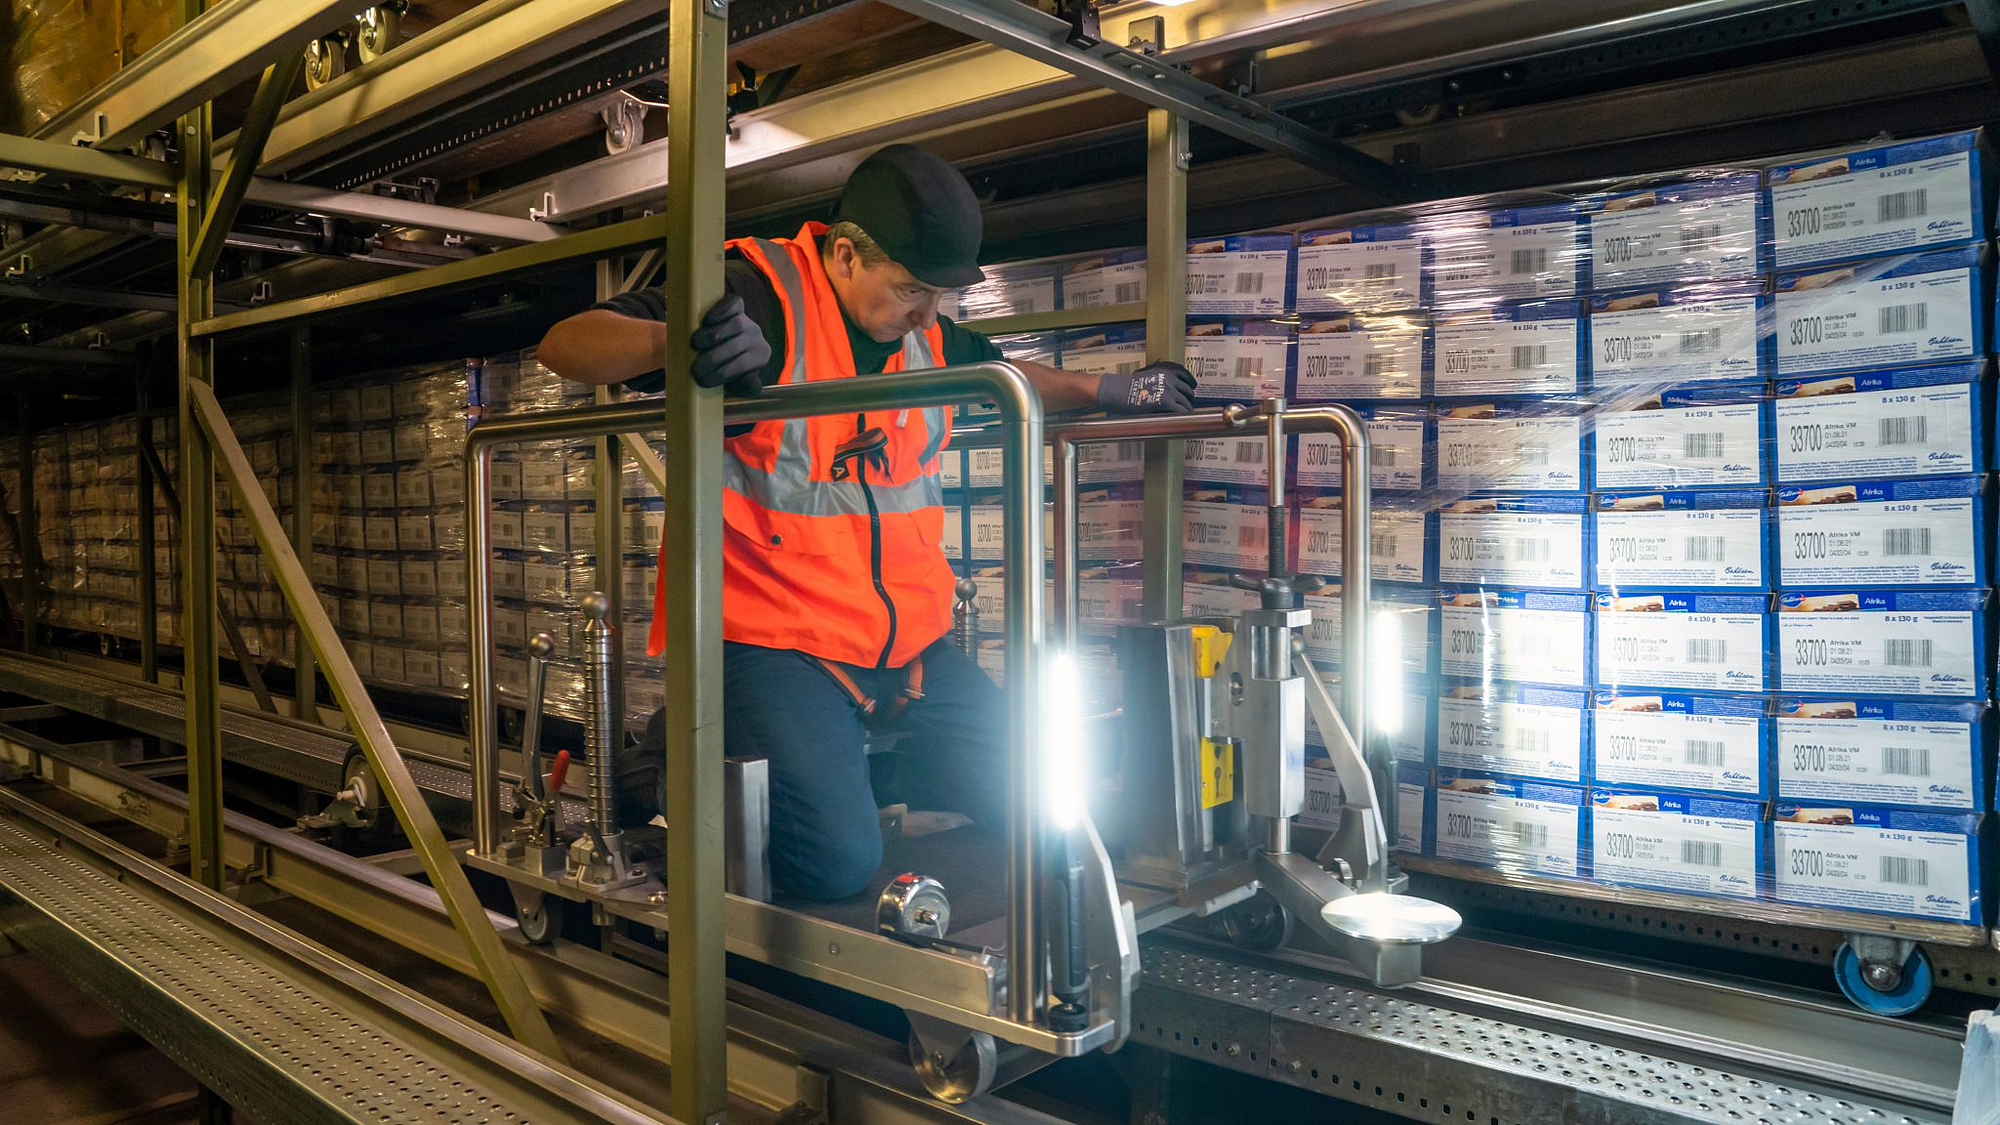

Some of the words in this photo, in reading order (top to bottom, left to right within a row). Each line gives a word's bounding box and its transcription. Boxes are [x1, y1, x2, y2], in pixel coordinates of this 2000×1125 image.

[1855, 157, 1875, 166] Afrika
[1788, 207, 1820, 238] 33700
[1790, 316, 1822, 345] 33700
[1604, 337, 1631, 363] 33700
[1609, 437, 1635, 462] 33700
[1791, 424, 1822, 452] 33700
[1450, 537, 1474, 560] 33700
[1610, 538, 1636, 562] 33700
[1795, 532, 1825, 559] 33700
[1312, 618, 1333, 640] 33700
[1452, 630, 1475, 654] 33700
[1796, 639, 1826, 665] 33700
[1450, 721, 1474, 746] 33700
[1610, 736, 1636, 761] 33700
[1794, 745, 1825, 772] 33700
[1309, 789, 1331, 813] 33700
[1607, 833, 1633, 858] 33700
[1792, 849, 1823, 877] 33700
